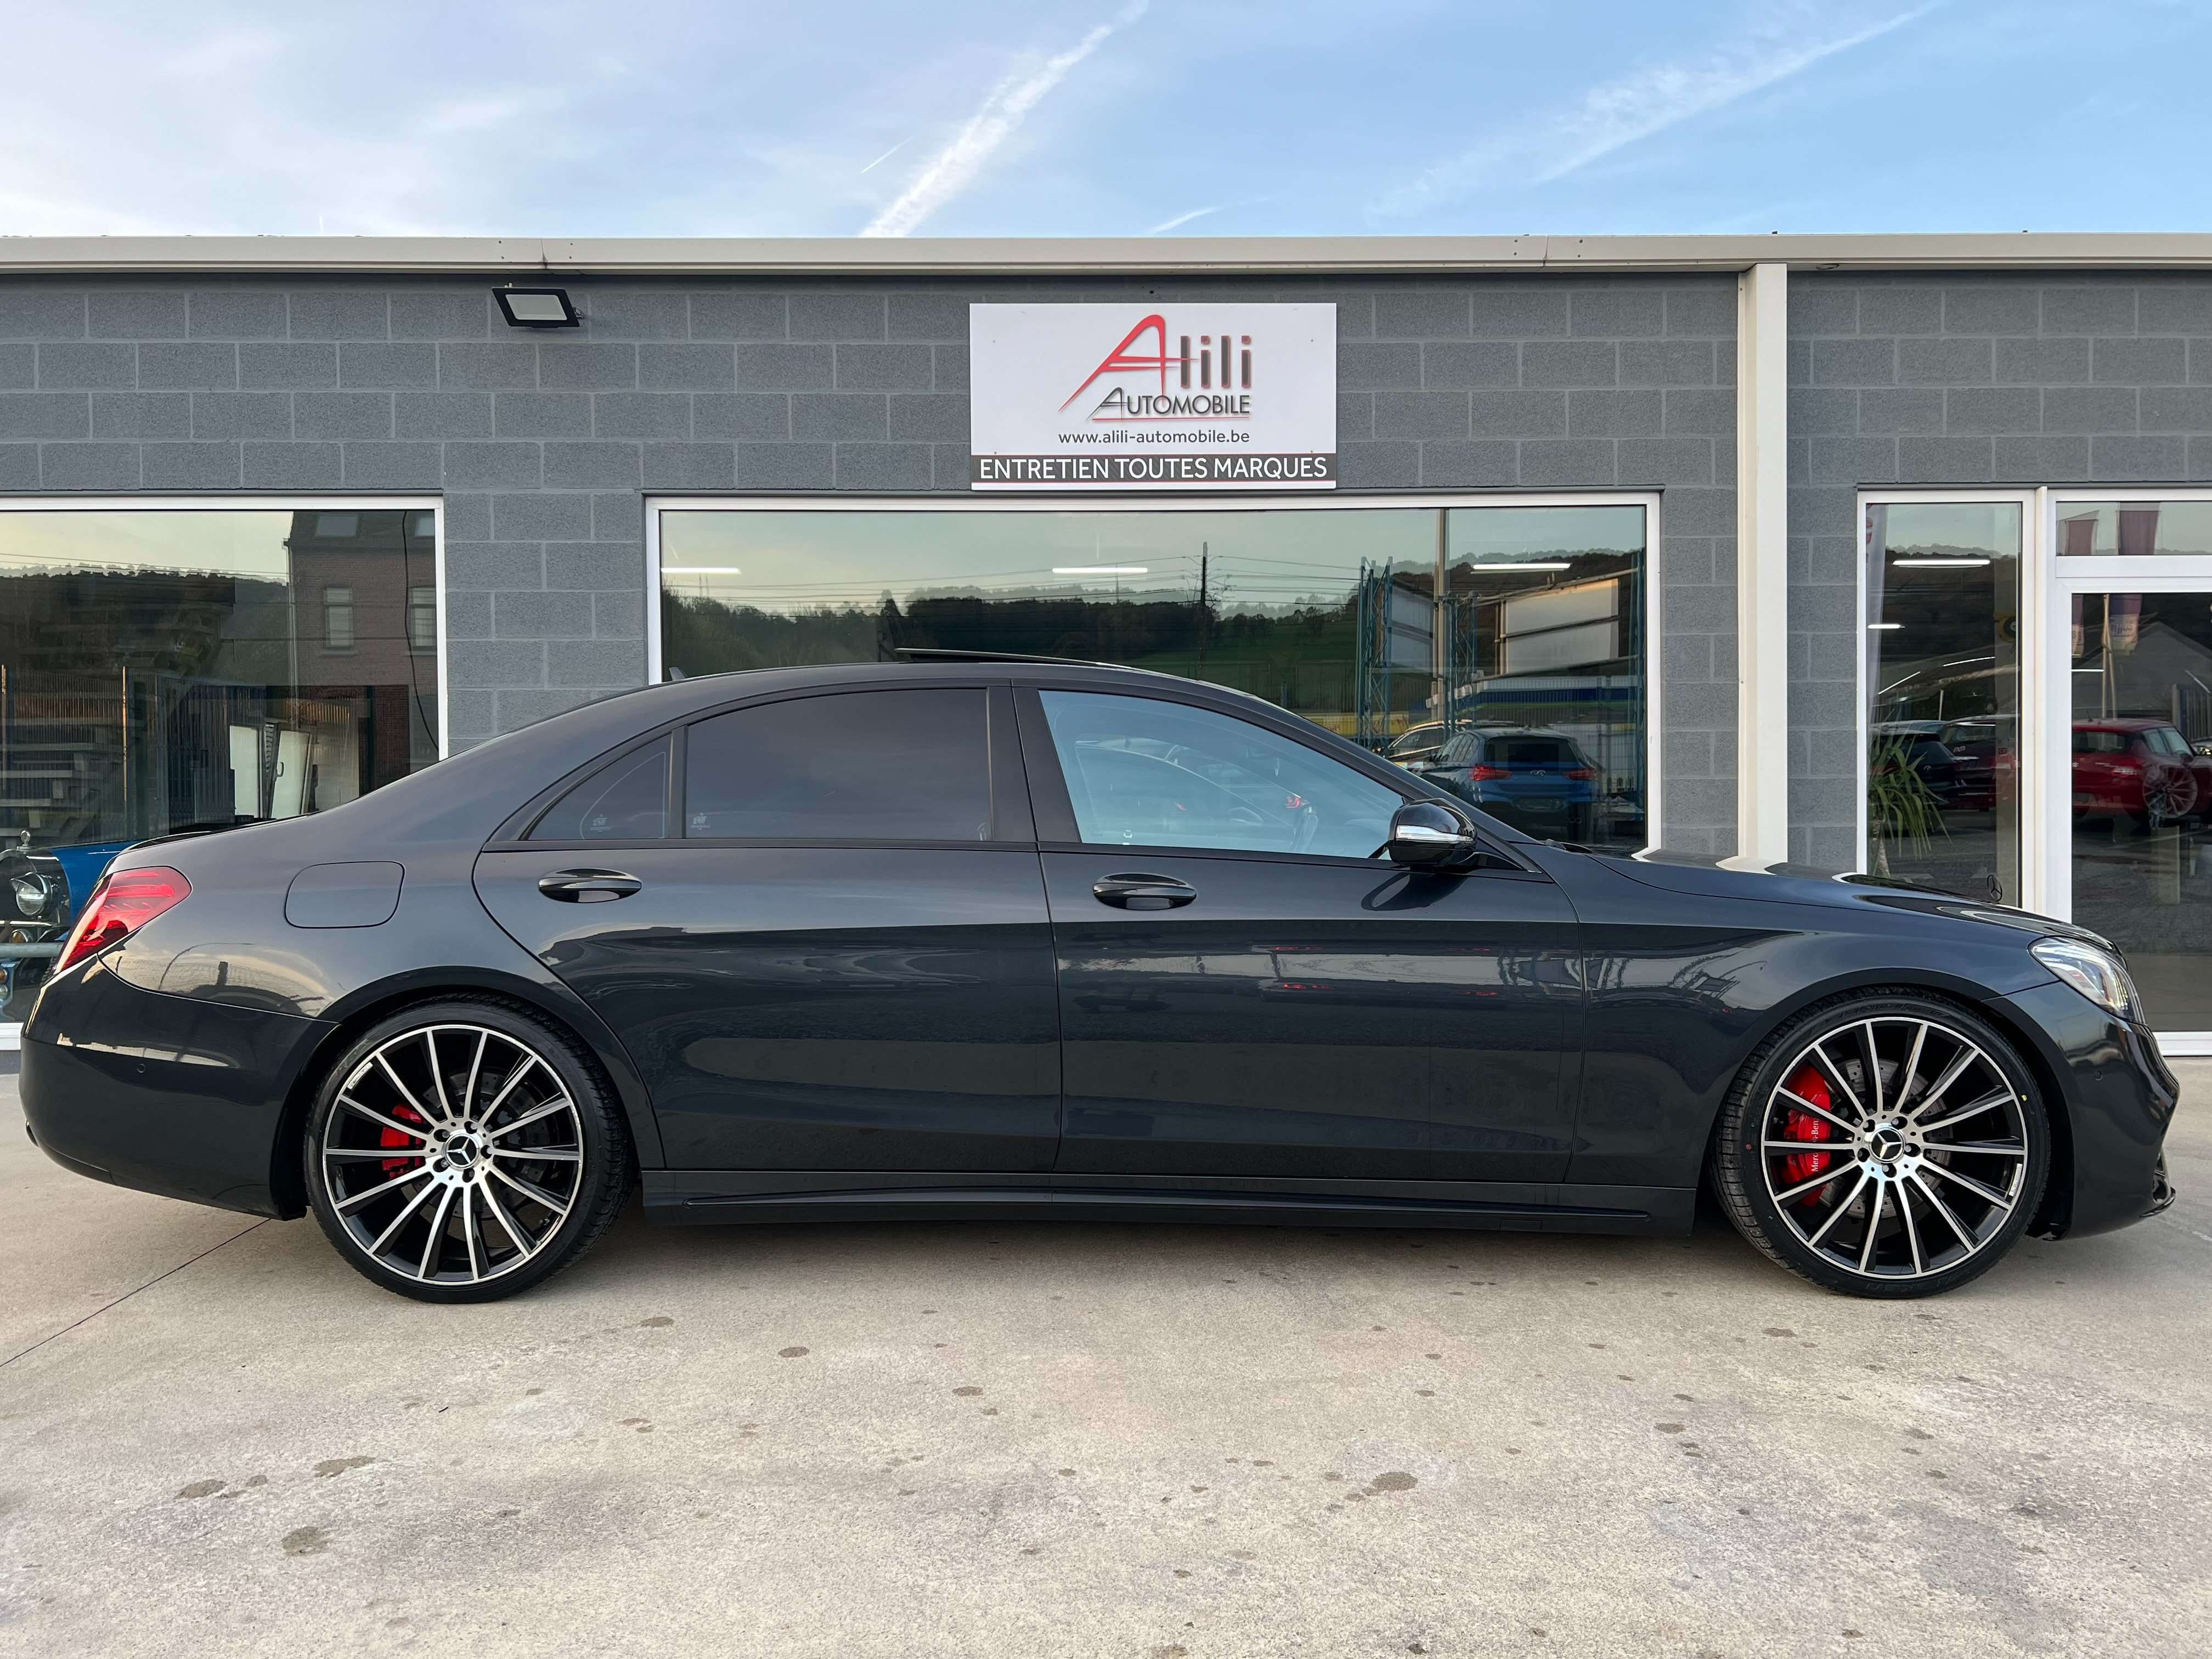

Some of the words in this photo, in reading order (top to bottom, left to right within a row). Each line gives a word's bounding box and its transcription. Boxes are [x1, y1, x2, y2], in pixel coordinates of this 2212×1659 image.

[1059, 314, 1252, 412] Alili
[1086, 387, 1250, 421] AUTOMOBILE
[1058, 429, 1250, 443] www.alili-automobile.be
[980, 459, 1109, 479] ENTRETIEN
[1117, 458, 1208, 479] TOUTES
[1214, 456, 1327, 479] MARQUES
